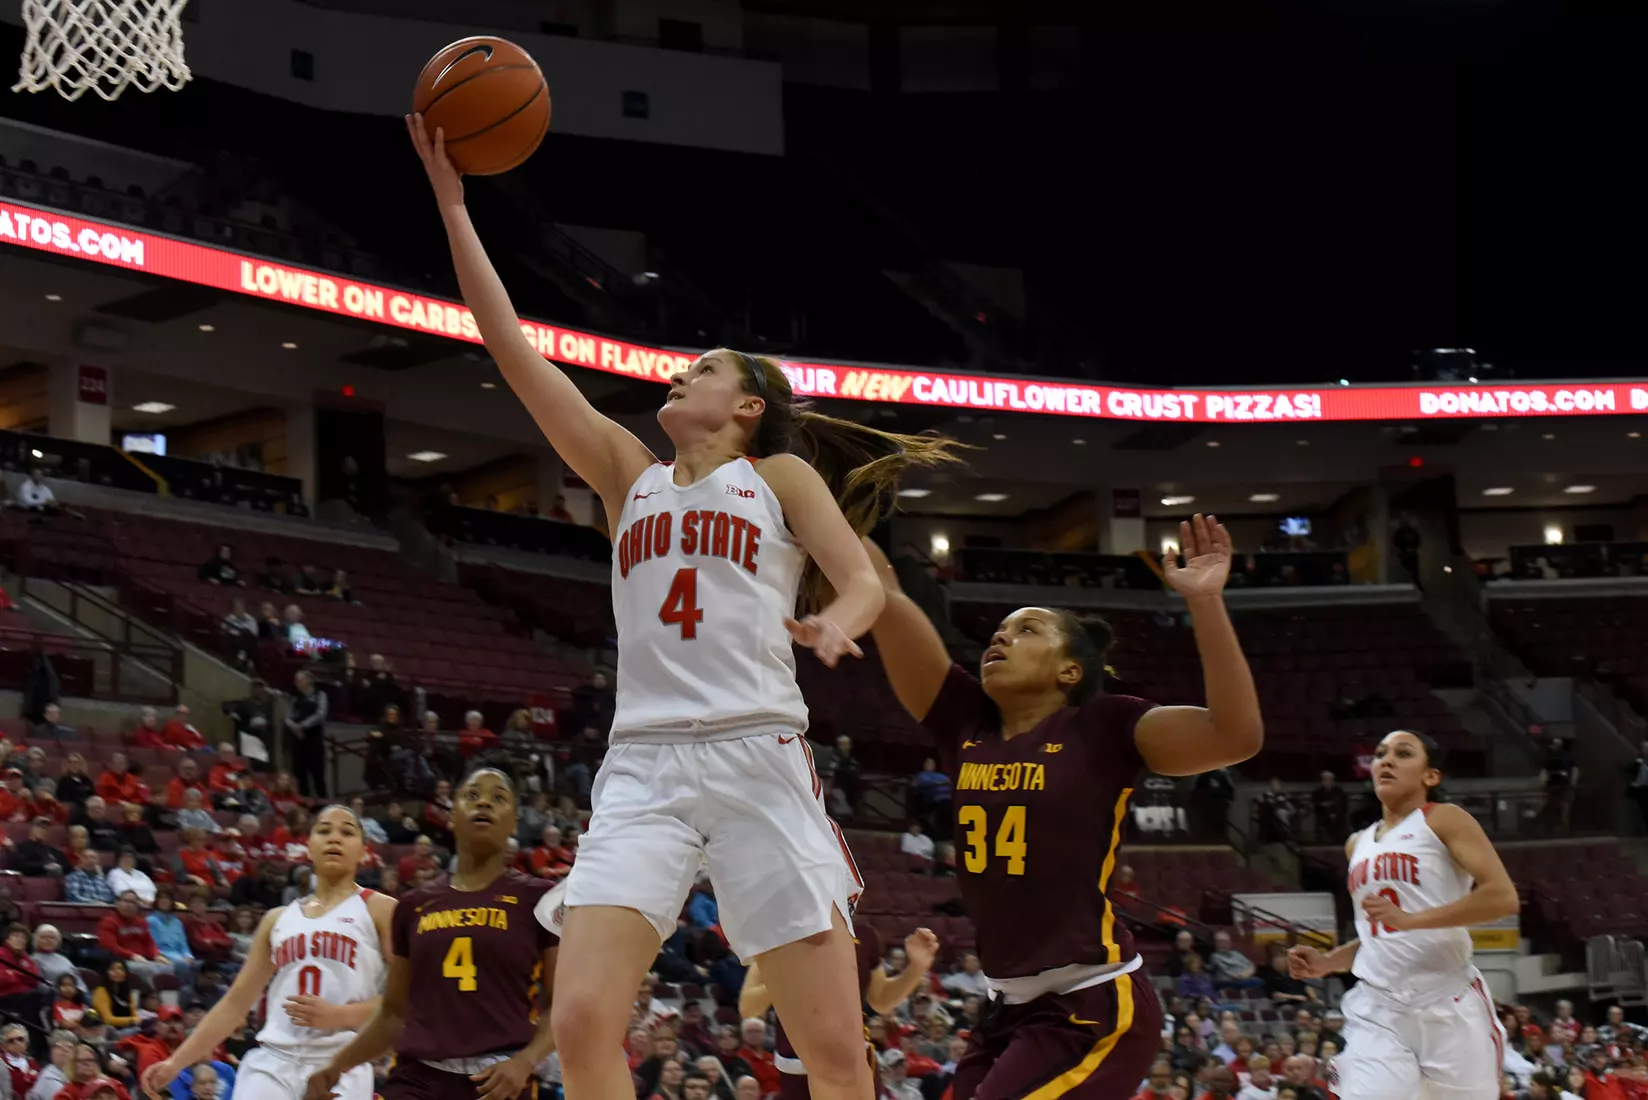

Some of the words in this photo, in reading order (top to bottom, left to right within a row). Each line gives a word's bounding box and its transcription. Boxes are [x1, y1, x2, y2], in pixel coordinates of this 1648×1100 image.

[240, 260, 339, 309] LOWER
[343, 285, 385, 318] ON
[519, 324, 555, 357] GH
[559, 333, 596, 365] ON
[840, 370, 913, 402] NEW
[912, 376, 1101, 414] CAULIFLOWER
[1107, 391, 1200, 419] CRUST
[1206, 394, 1322, 419] PIZZAS!
[1419, 389, 1616, 414] DONATOS.COM
[618, 511, 673, 580] OHIO
[680, 510, 762, 576] STATE
[658, 567, 704, 641] 4
[958, 805, 1027, 876] 34
[1374, 852, 1420, 887] STATE
[311, 930, 357, 970] STATE
[442, 937, 477, 991] 4
